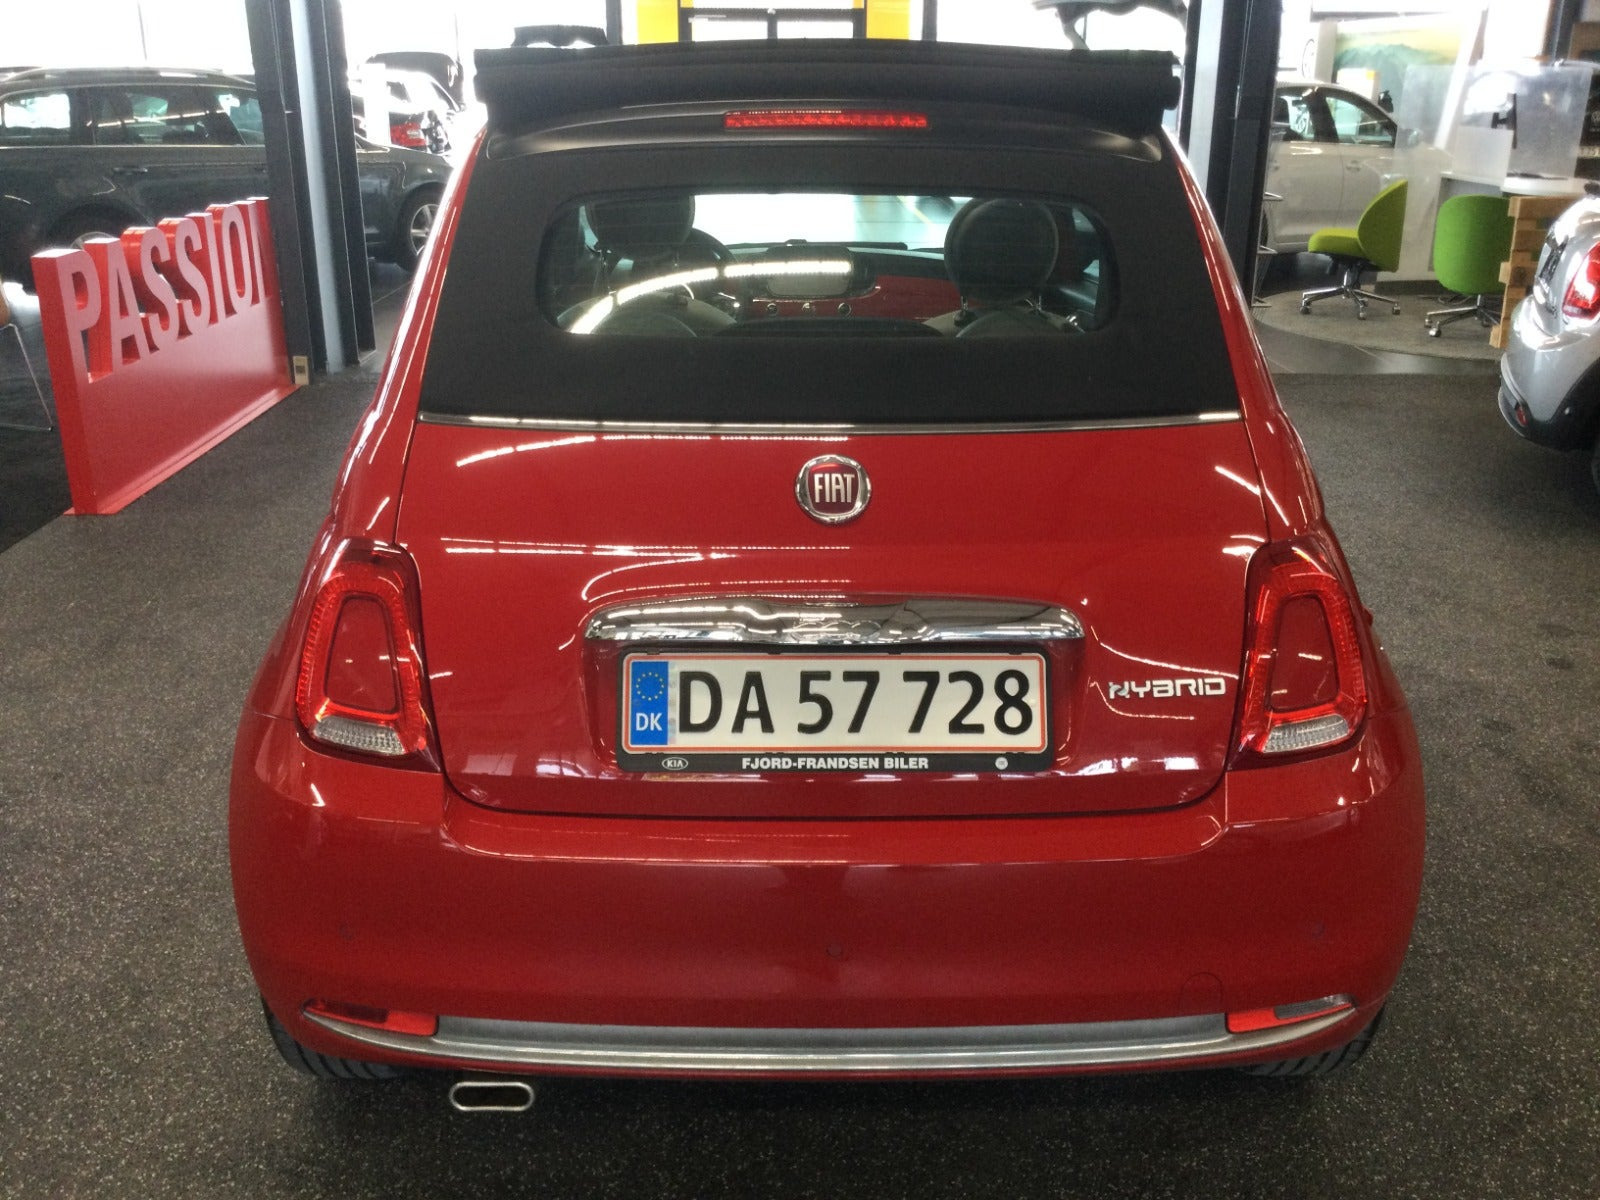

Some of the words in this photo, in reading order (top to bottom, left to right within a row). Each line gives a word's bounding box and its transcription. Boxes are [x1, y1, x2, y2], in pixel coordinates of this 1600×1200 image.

[814, 473, 855, 503] FIAT
[1108, 678, 1226, 699] HYBRID
[679, 670, 775, 734] DA
[797, 670, 880, 735] 57
[902, 669, 1034, 736] 728
[635, 712, 662, 732] DK
[664, 758, 686, 769] KIA
[741, 757, 878, 770] FJORD-FRANDSEN
[883, 757, 929, 770] BILER
